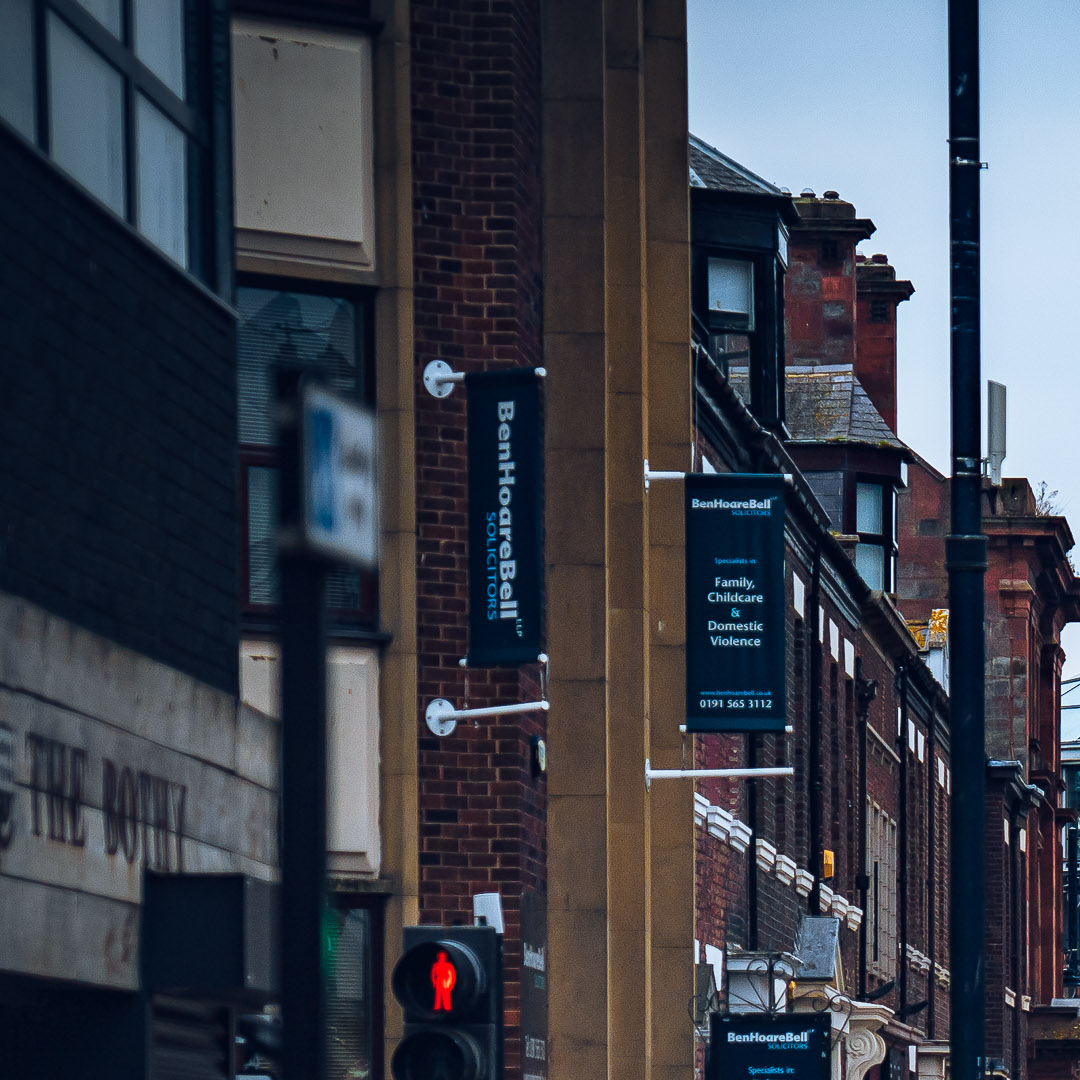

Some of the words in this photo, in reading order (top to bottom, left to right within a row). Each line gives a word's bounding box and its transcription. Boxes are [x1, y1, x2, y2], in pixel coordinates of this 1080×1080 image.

[691, 498, 771, 509] BenHoareBell
[497, 400, 518, 619] BenHoareBell
[486, 511, 498, 621] SOLICITORS
[714, 577, 756, 590] Family,
[707, 592, 764, 603] Childcare
[730, 607, 741, 617] &
[707, 620, 764, 631] Domestic
[710, 635, 762, 646] Violence
[700, 699, 723, 709] 0191
[726, 699, 745, 709] 565
[748, 699, 772, 709] 3112
[727, 1031, 808, 1042] BenHoareBell
[747, 1066, 785, 1076] Specialists
